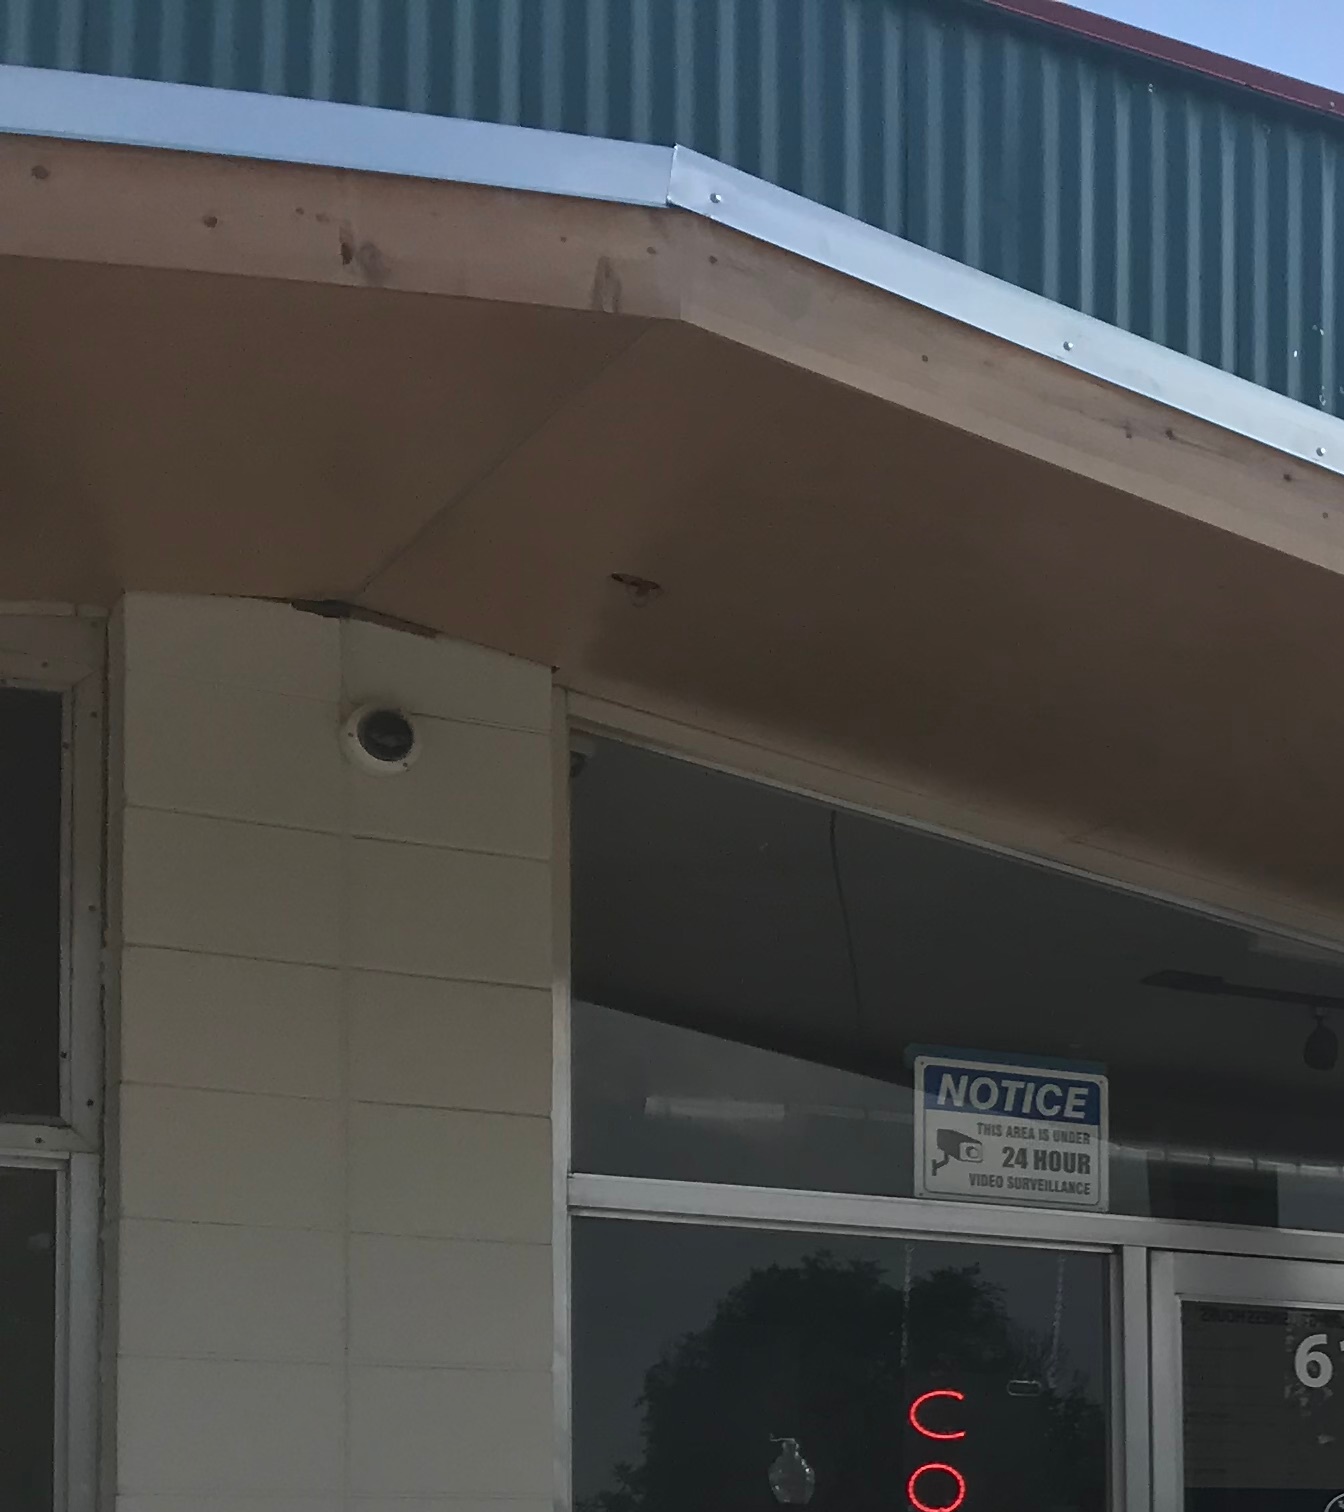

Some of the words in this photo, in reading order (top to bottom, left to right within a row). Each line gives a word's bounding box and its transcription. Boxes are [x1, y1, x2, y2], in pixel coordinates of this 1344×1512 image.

[937, 1073, 1089, 1119] NOTICE
[977, 1122, 1003, 1138] THIS
[1006, 1125, 1035, 1140] AREA
[1039, 1128, 1050, 1141] IS
[1052, 1130, 1091, 1145] UNDER
[1002, 1146, 1028, 1170] 24
[1033, 1150, 1091, 1175] HOUR
[969, 1172, 1004, 1189] VIDEO
[1007, 1176, 1091, 1196] SURVEILLANCE
